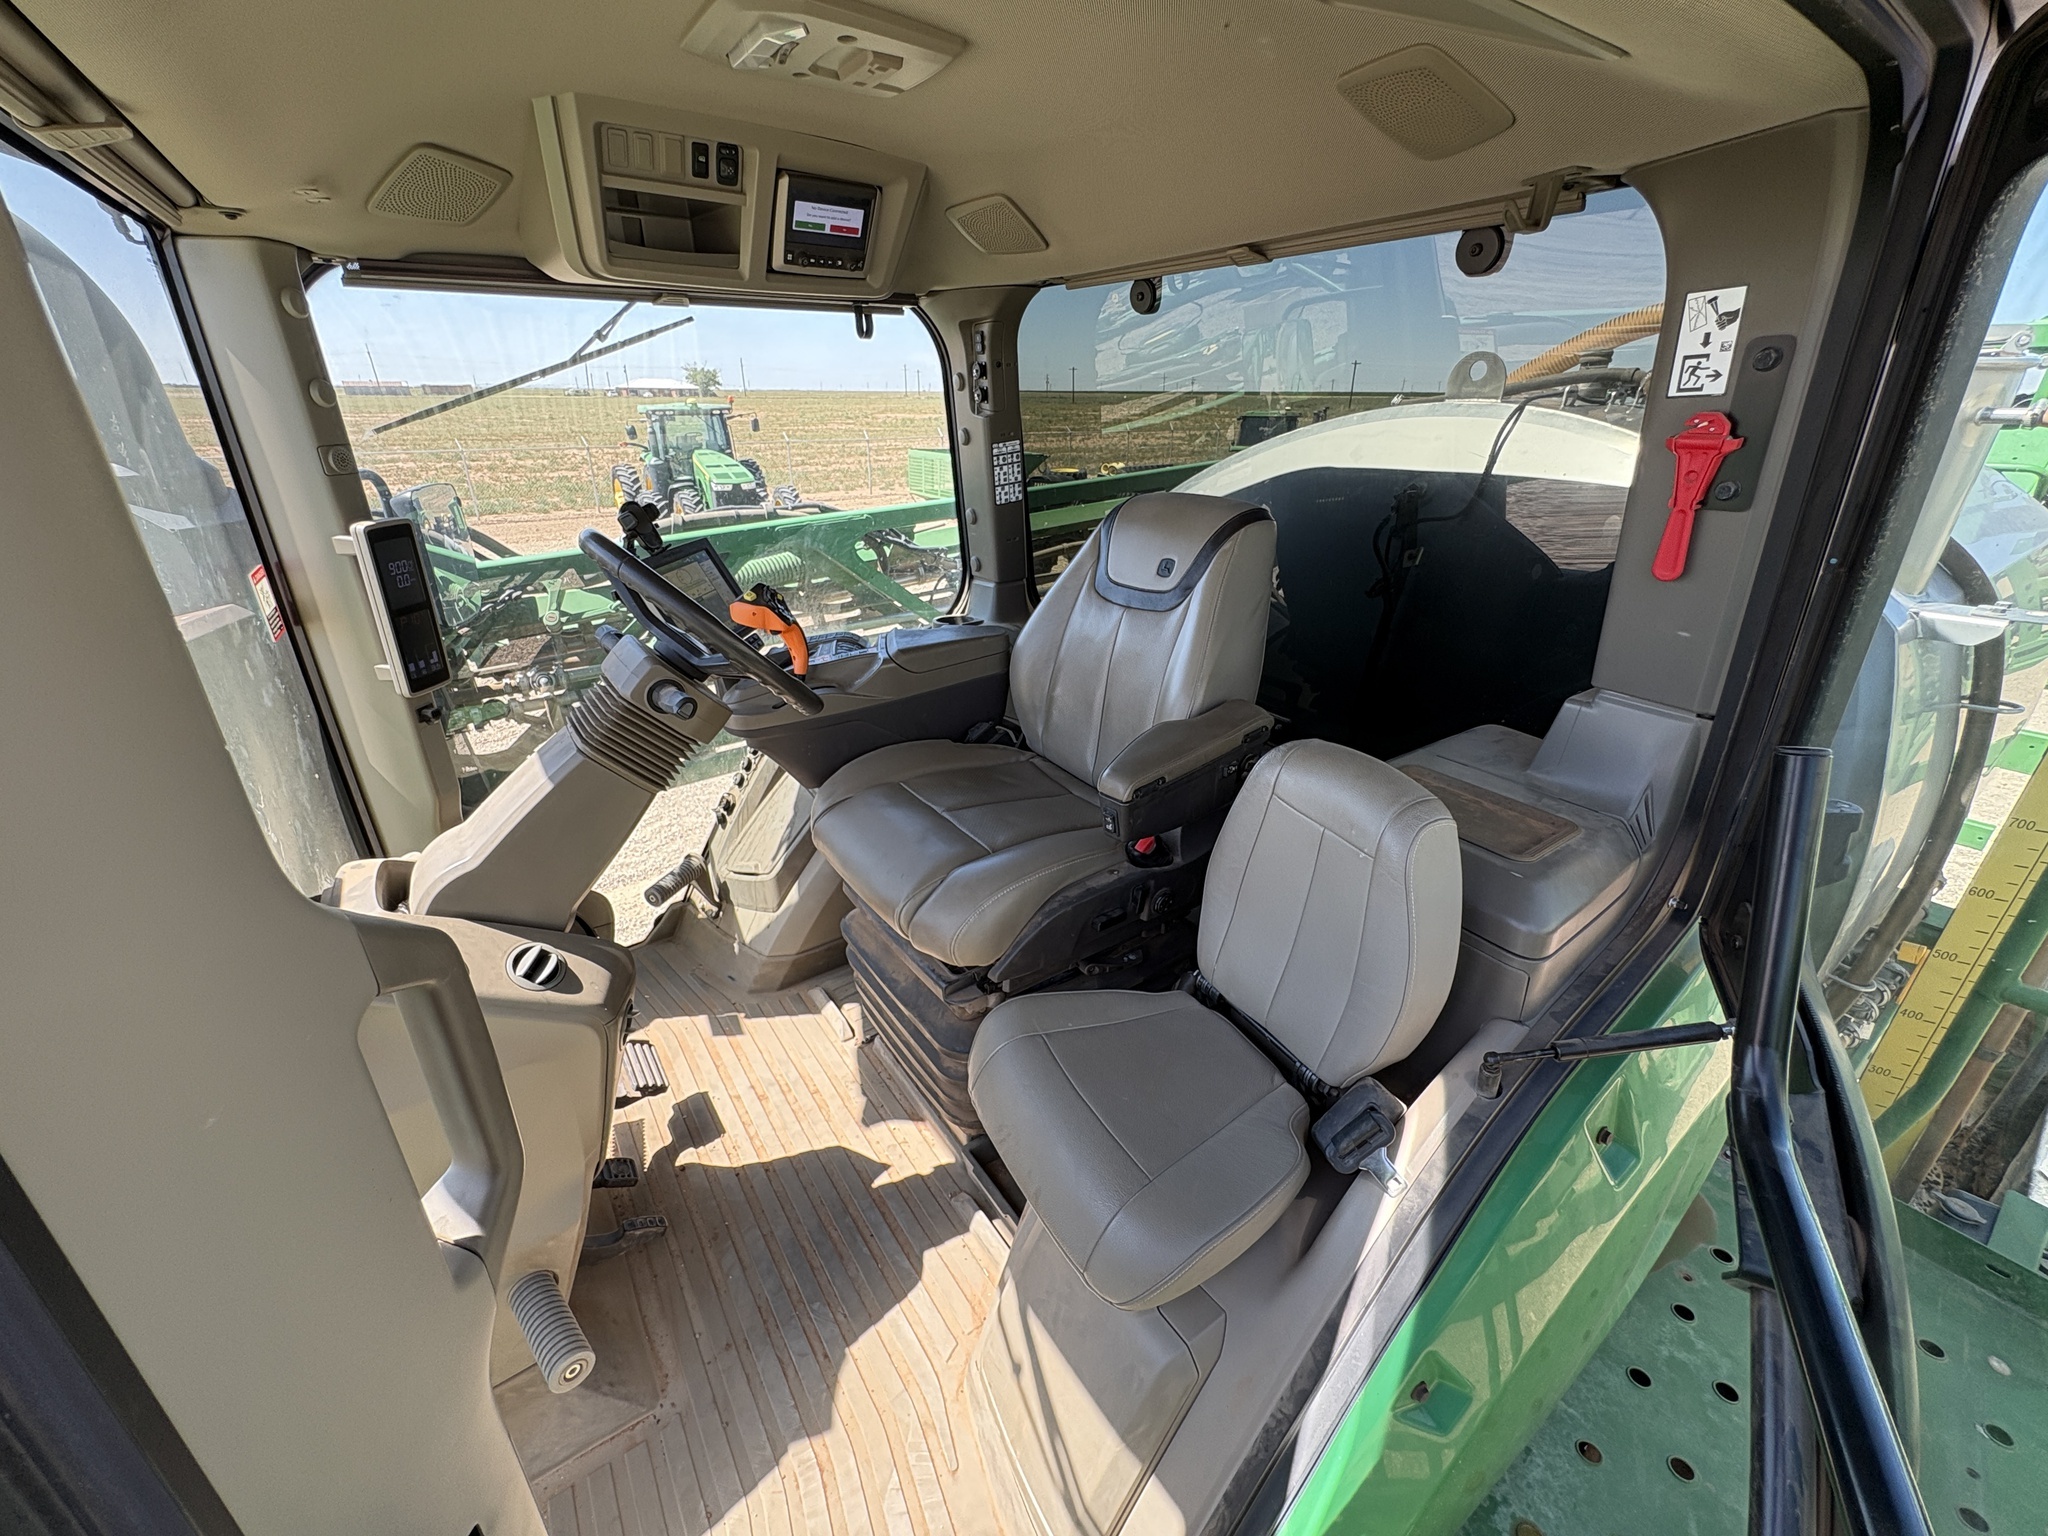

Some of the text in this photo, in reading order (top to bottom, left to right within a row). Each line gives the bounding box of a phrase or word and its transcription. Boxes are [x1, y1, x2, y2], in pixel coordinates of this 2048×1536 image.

[388, 560, 408, 576] 900
[396, 573, 411, 589] 0.0
[2008, 816, 2037, 831] 700
[1968, 886, 1995, 899] 600
[1932, 949, 1958, 962] 500
[1900, 1008, 1924, 1021] 400
[1867, 1064, 1892, 1077] 300
